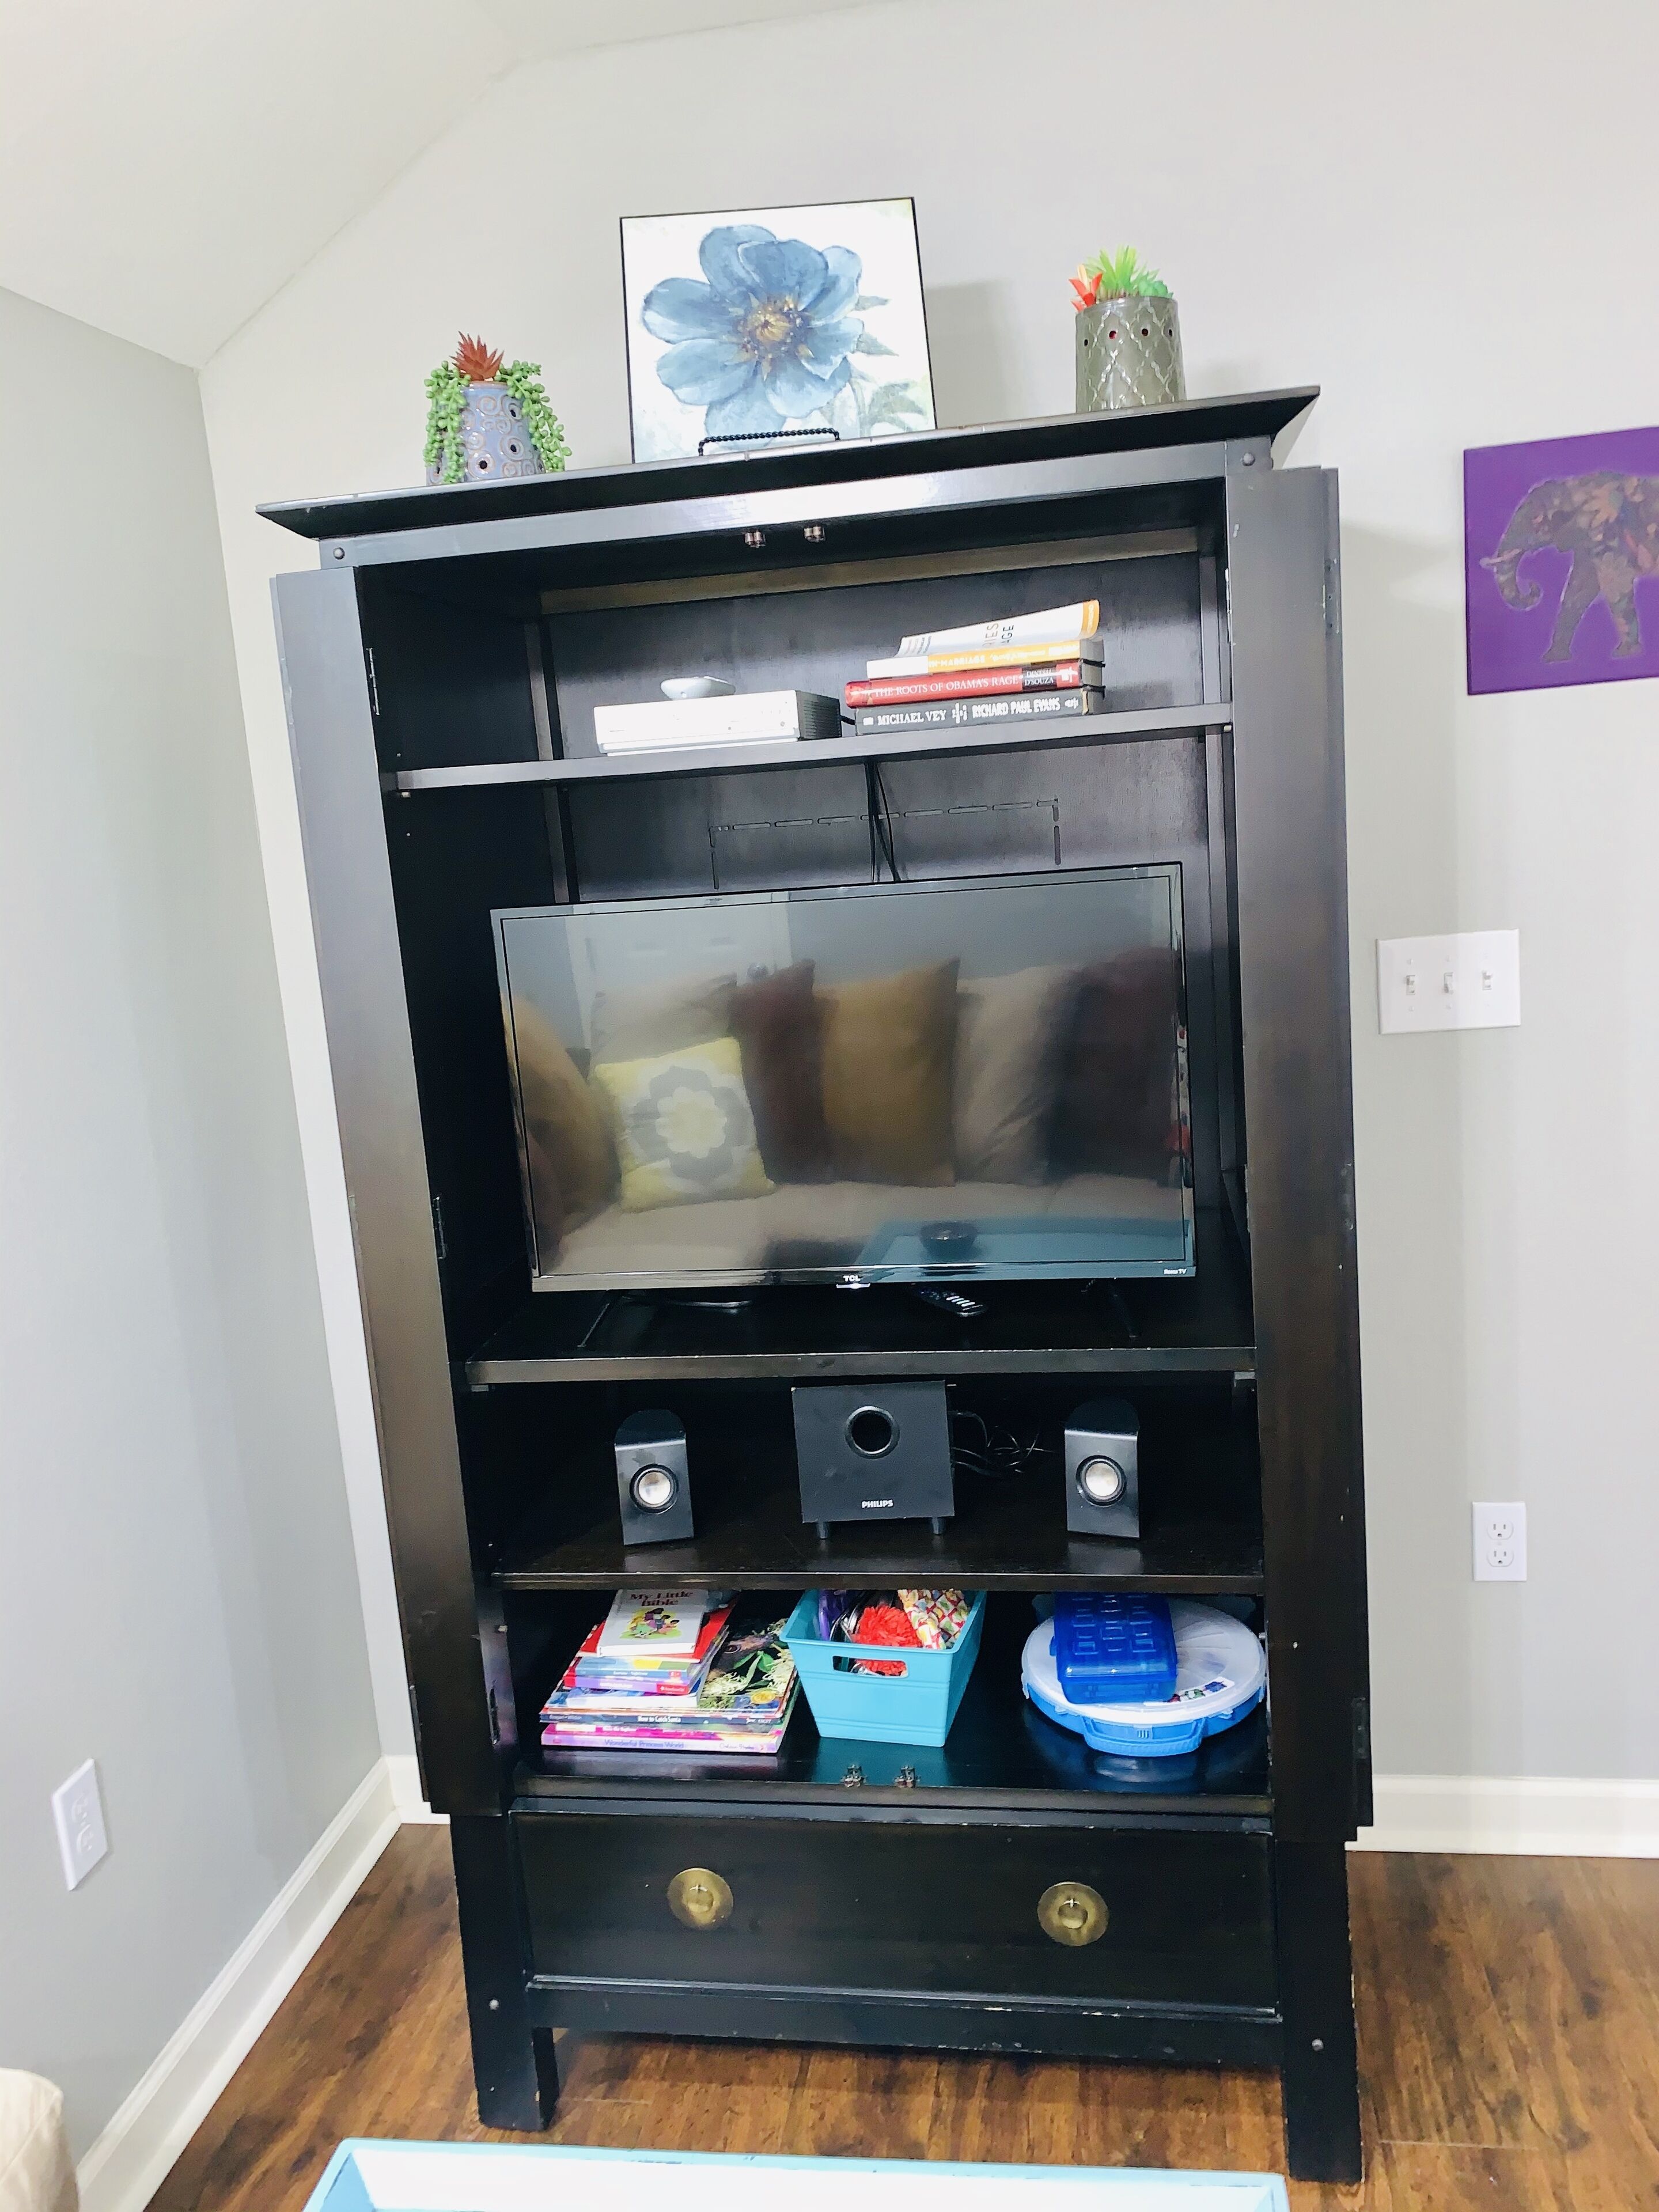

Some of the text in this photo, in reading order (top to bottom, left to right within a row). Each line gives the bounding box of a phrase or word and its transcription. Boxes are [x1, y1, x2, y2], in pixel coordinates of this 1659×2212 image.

[875, 675, 1019, 697] THE ROOTS OF OBAMA'S RAGE
[1025, 676, 1054, 686] D'SOUZA
[972, 702, 1009, 718] RICHARD
[1010, 700, 1032, 715] PAUL
[1033, 697, 1061, 713] EVANS
[877, 710, 947, 726] MICHAEL VEY
[861, 1499, 893, 1509] PHILIPS
[630, 1591, 693, 1601] My Little
